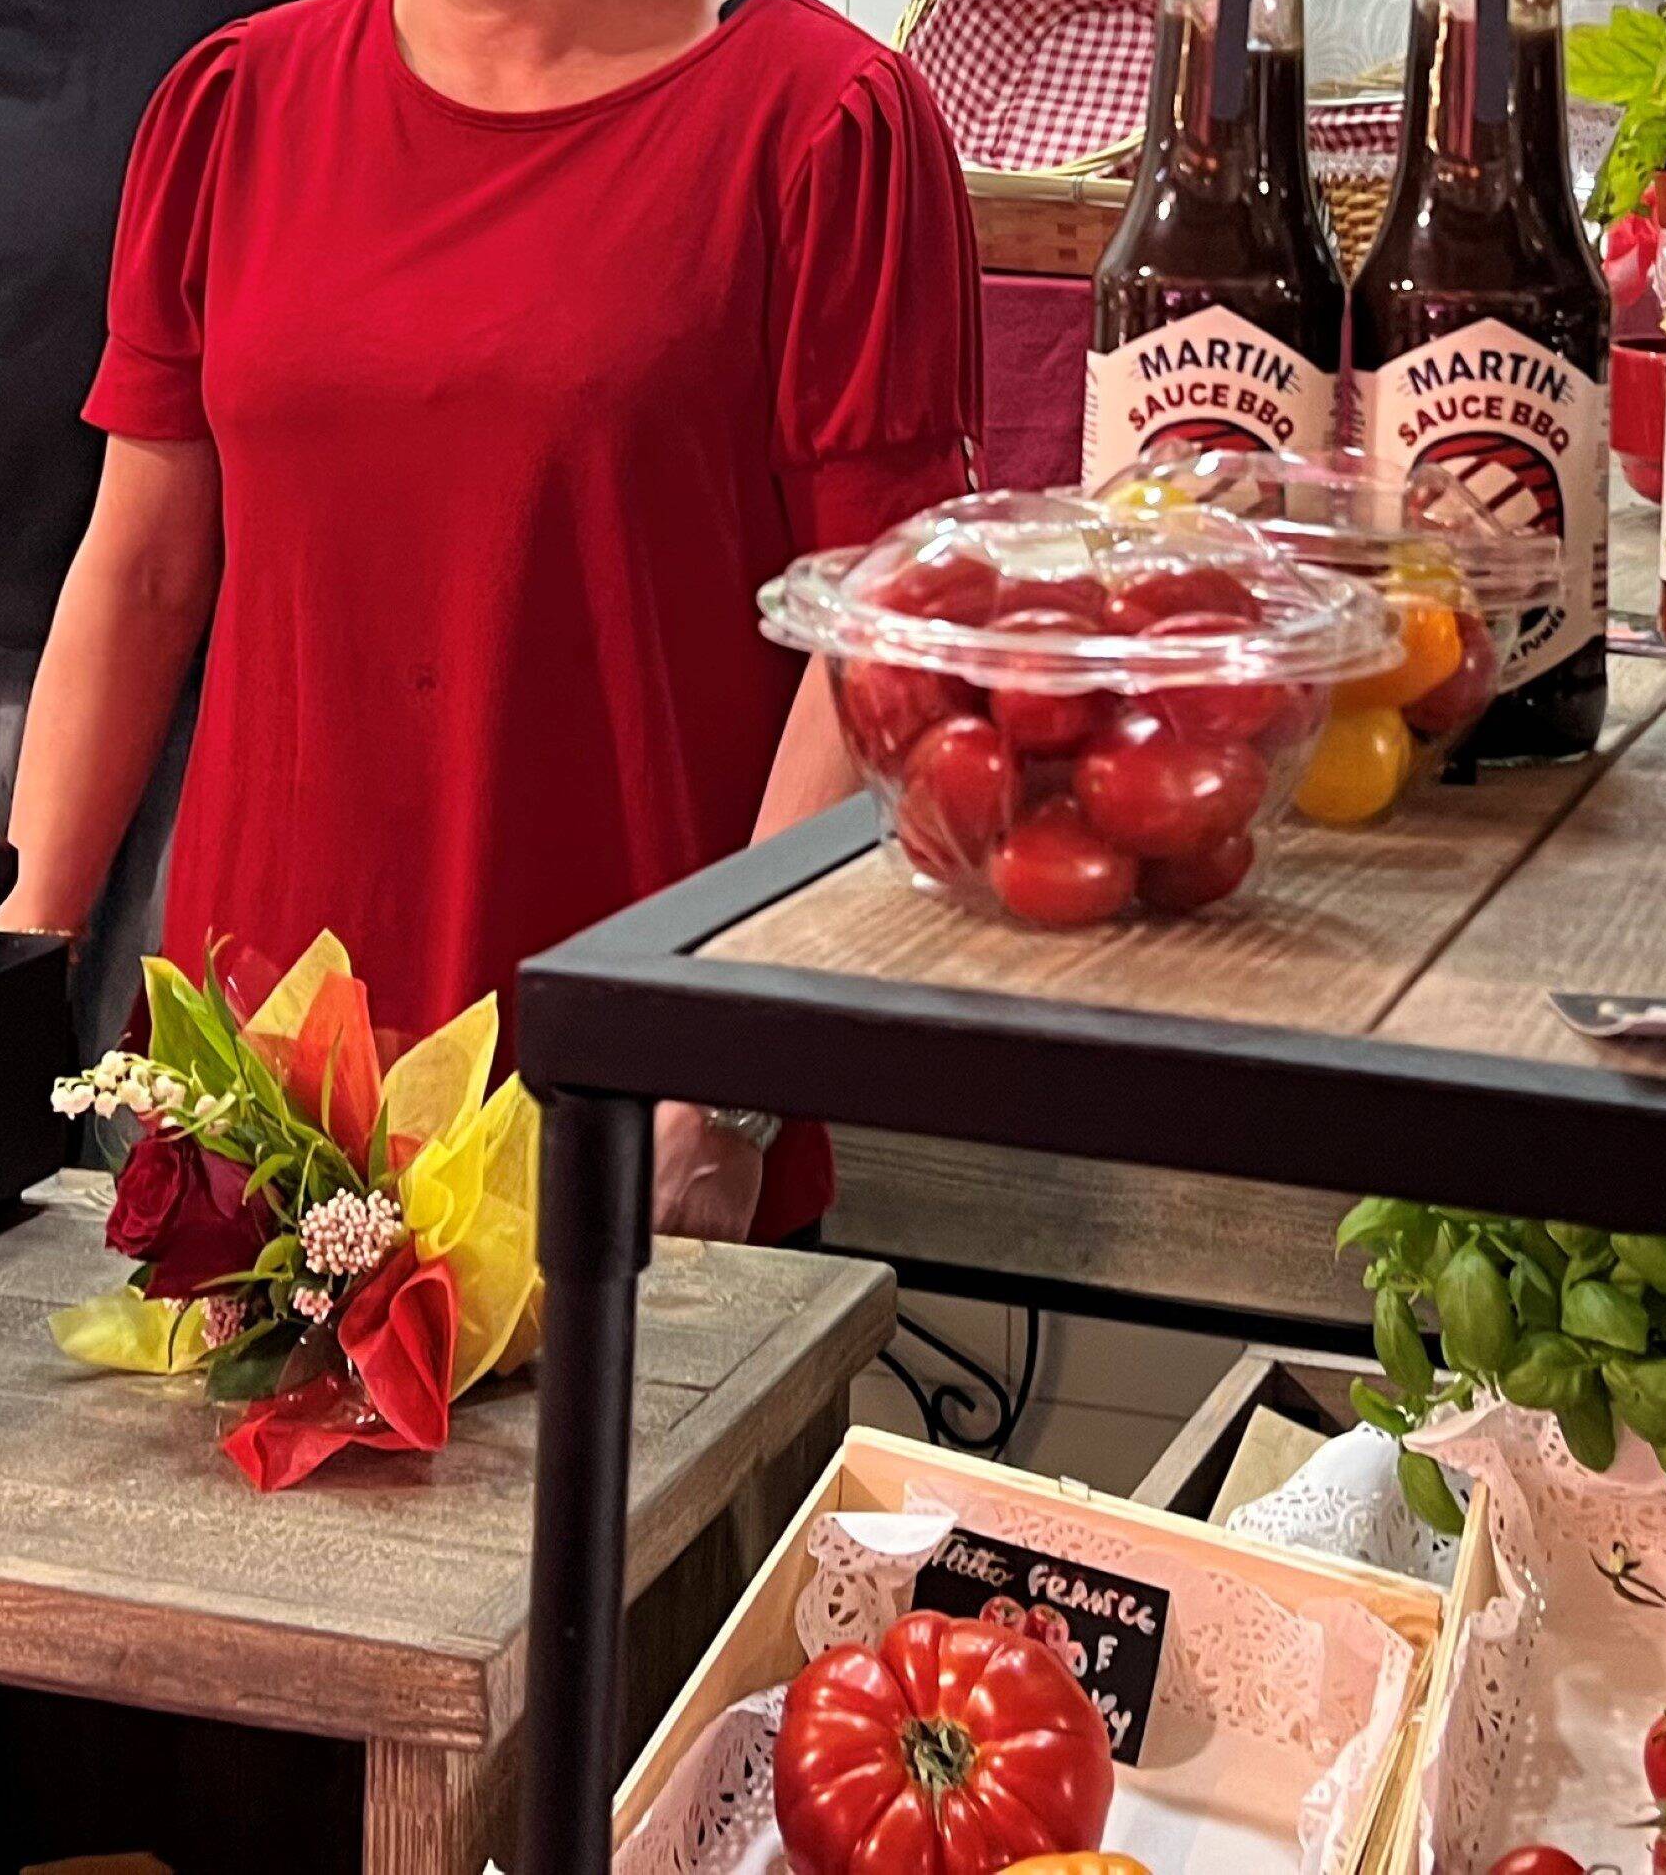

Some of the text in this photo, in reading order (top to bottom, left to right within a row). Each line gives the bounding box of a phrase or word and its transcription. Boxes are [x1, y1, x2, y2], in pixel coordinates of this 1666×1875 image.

[1139, 338, 1294, 392] MARTIN
[1408, 350, 1567, 403] MARTIN
[1128, 382, 1230, 432] SAUCE
[1237, 388, 1294, 445] BBQ
[1398, 395, 1503, 446] SAUCE
[1510, 400, 1570, 456] BBQ
